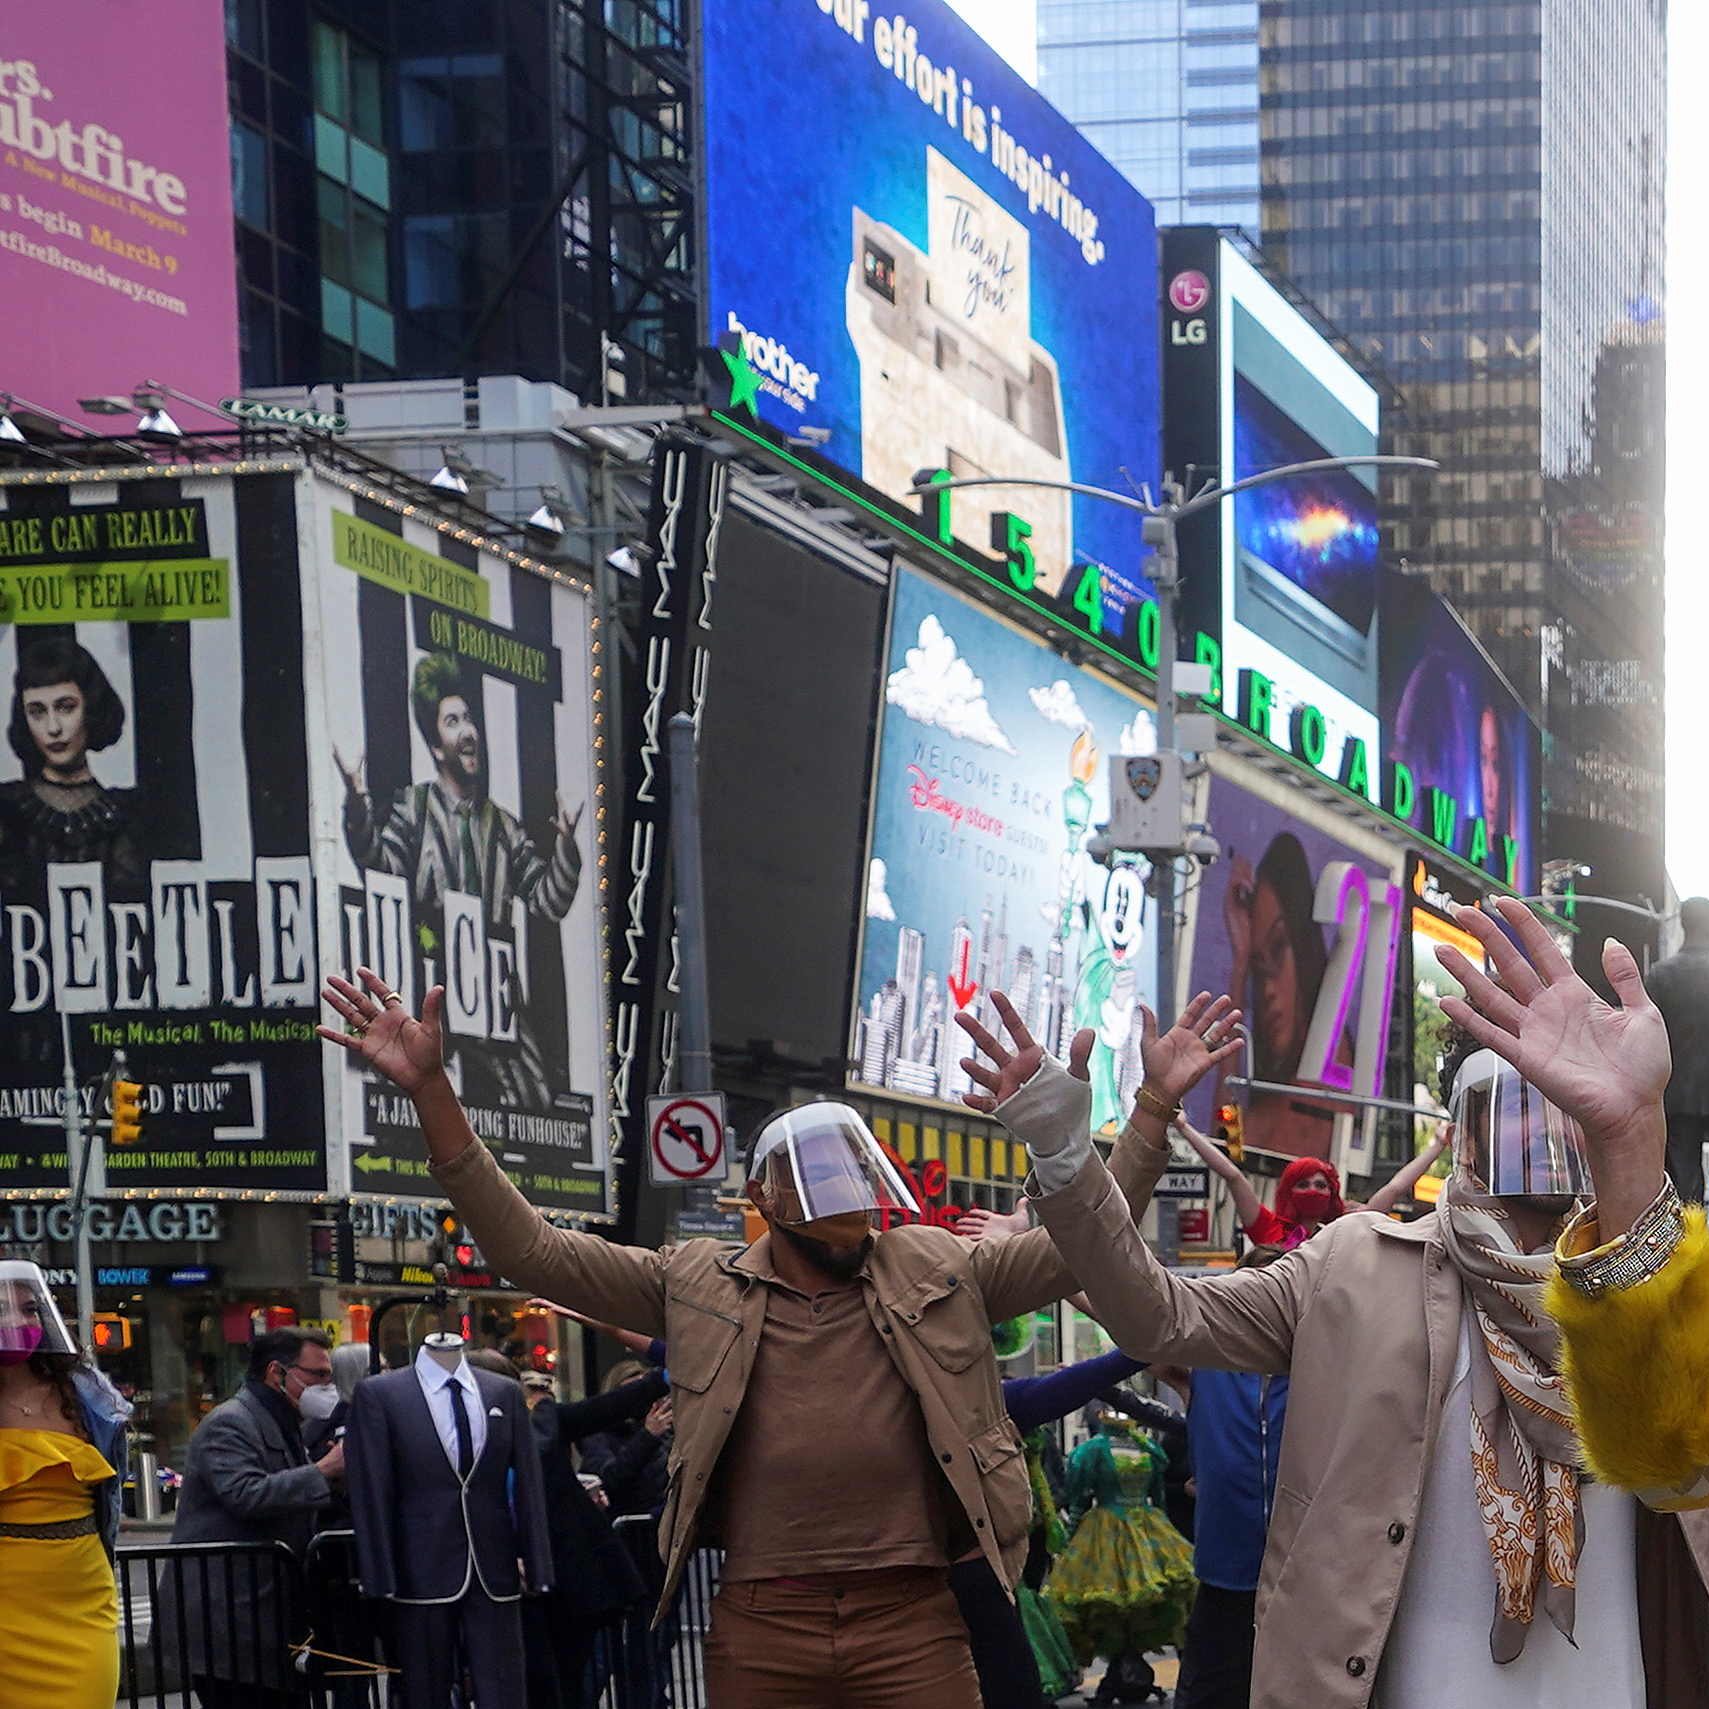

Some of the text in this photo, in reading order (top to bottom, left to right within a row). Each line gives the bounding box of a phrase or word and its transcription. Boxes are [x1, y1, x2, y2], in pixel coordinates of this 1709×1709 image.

[873, 15, 958, 128] effort
[962, 78, 987, 153] is
[990, 105, 1105, 266] inspiring.
[17, 194, 179, 274] begin March 9
[1172, 320, 1206, 345] LG
[231, 400, 336, 428] LAMAR
[51, 513, 98, 552] CAN
[106, 507, 196, 549] REALLY
[17, 575, 63, 611] YOU
[75, 571, 134, 608] FEEL
[145, 567, 221, 606] ALIVE!
[347, 526, 478, 612] RAISING SPIRITS
[429, 610, 548, 683] ON BROADWAY!
[913, 738, 1001, 796] WELCOME
[1196, 631, 1520, 888] BROADWAY
[918, 822, 966, 861] VISIT
[966, 808, 1004, 838] store
[91, 1021, 123, 1045] The
[210, 1020, 245, 1043] The
[250, 1149, 316, 1167] BROADWAY
[1168, 1176, 1196, 1188] WAY
[350, 1202, 438, 1243] GIFTS
[40, 1267, 79, 1286] ONY
